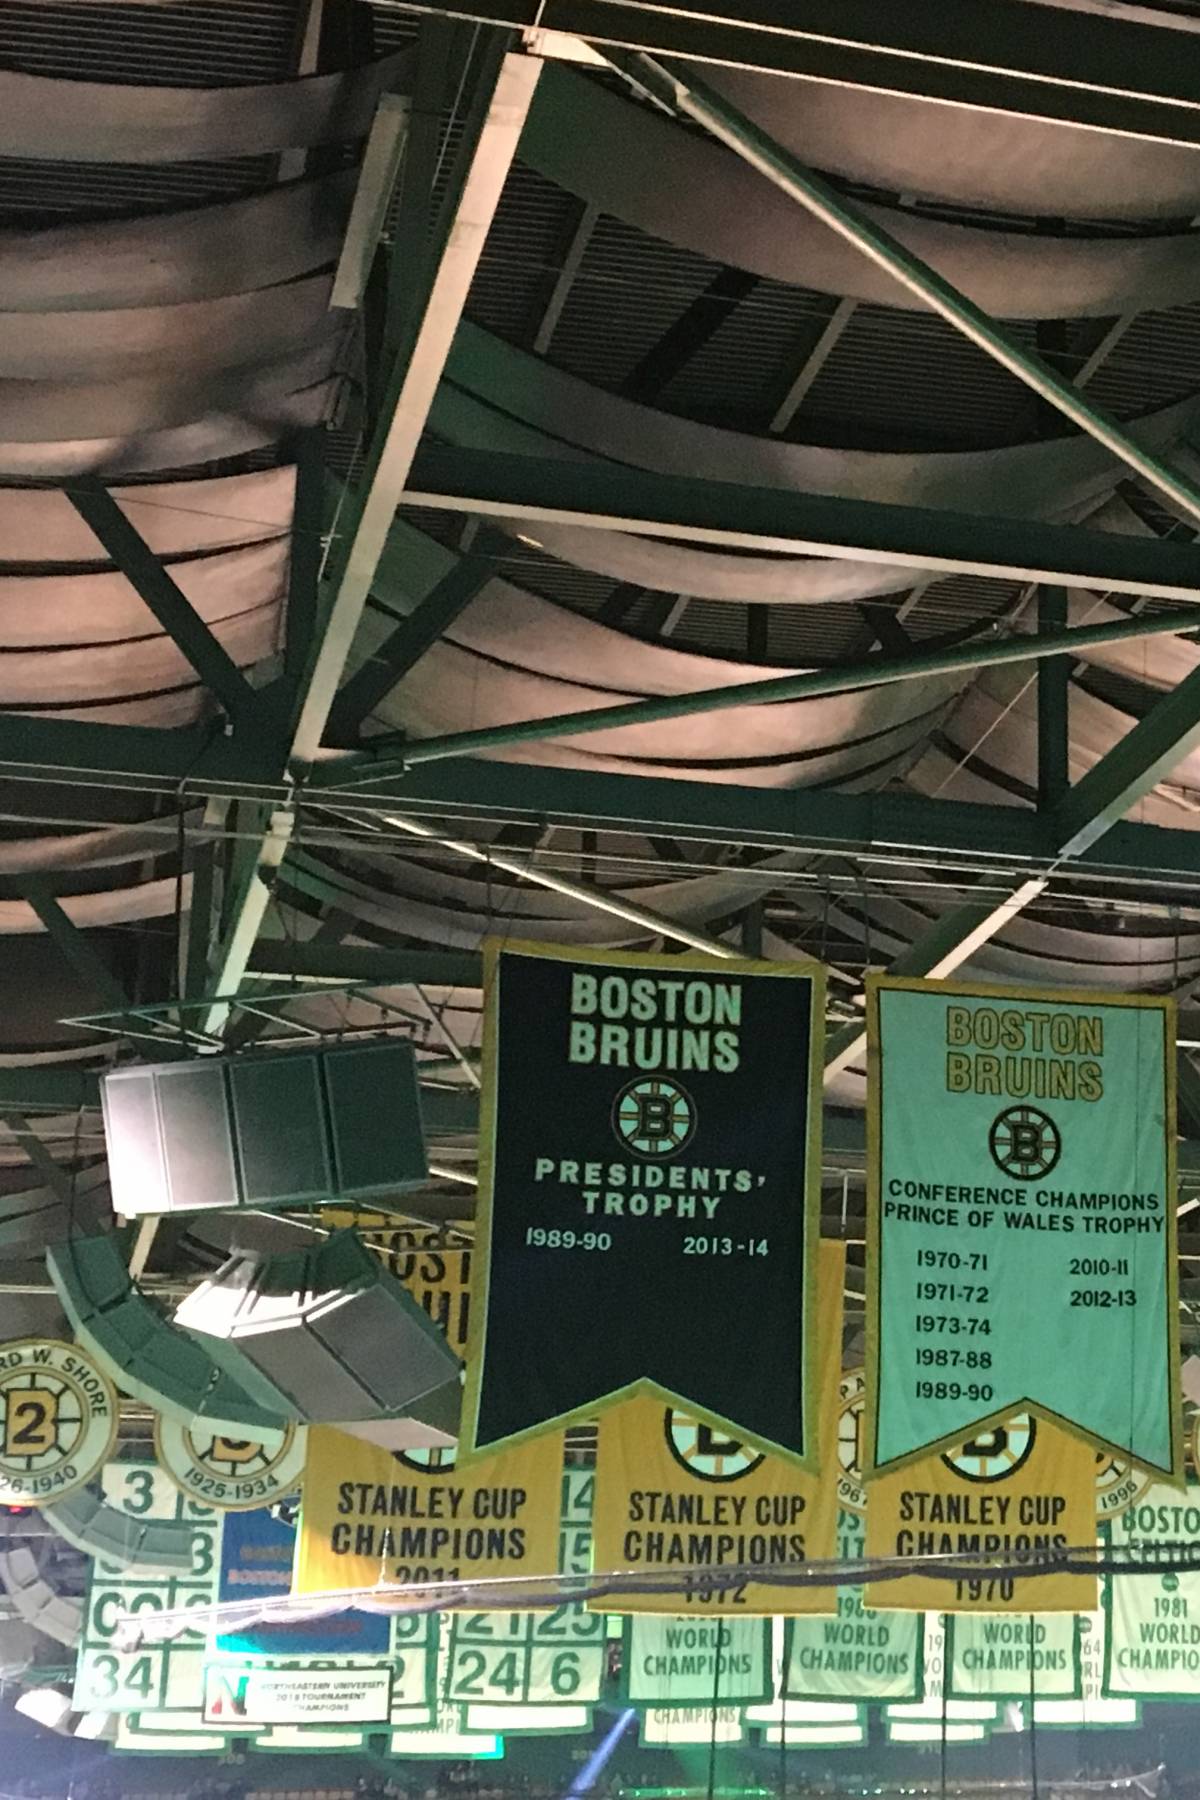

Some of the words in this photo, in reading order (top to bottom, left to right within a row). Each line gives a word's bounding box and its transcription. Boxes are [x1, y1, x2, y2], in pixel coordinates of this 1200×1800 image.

[570, 973, 742, 1026] BOSTON
[946, 1006, 1104, 1056] BOSTON
[567, 1021, 741, 1074] BRUINS
[946, 1051, 1104, 1102] BRUINS
[534, 1158, 767, 1193] PRESIDENTS'
[581, 1191, 722, 1219] TROPHY
[888, 1178, 1027, 1206] CONFERENCE
[1036, 1190, 1160, 1211] CHAMPIONS
[884, 1201, 960, 1227] PRINCE
[968, 1210, 995, 1228] OF
[1004, 1212, 1075, 1232] WALES
[1083, 1216, 1165, 1234] TROPHY
[525, 1227, 613, 1252] 1989-90
[682, 1237, 770, 1257] 2013-14
[916, 1249, 989, 1271] 1970-71
[1069, 1258, 1129, 1276] 2010-11
[916, 1282, 989, 1303] 1971-72
[1069, 1290, 1137, 1307] 2012-13
[915, 1315, 992, 1336] 1973-74
[915, 1348, 993, 1369] 1987-88
[61, 1356, 108, 1418] SHORE
[915, 1381, 994, 1401] 1989-90
[12, 1402, 47, 1444] 2
[122, 1470, 155, 1514] 3
[183, 1467, 279, 1499] 1925-1934
[337, 1482, 465, 1519] STANLEY
[472, 1487, 527, 1520] CUP
[628, 1491, 747, 1526] STANLEY
[755, 1495, 806, 1526] CUP
[900, 1490, 1011, 1525] STANLEY
[1019, 1496, 1066, 1526] CUP
[331, 1523, 526, 1560] CHAMPIONS
[623, 1530, 805, 1565] CHAMPIONS
[896, 1529, 1068, 1563] CHAMPIONS
[683, 1574, 747, 1604] 1972
[955, 1575, 1015, 1602] 1970
[1154, 1597, 1188, 1619] 1981
[666, 1628, 733, 1649] WORLD
[824, 1623, 890, 1647] WORLD
[983, 1623, 1046, 1644] WORLD
[454, 1649, 520, 1696] 24
[550, 1651, 581, 1696] 6
[643, 1654, 753, 1677] CHAMPIONS
[800, 1647, 910, 1674] CHAMPIONS
[962, 1649, 1067, 1670] CHAMPIONS
[91, 1654, 155, 1699] 34
